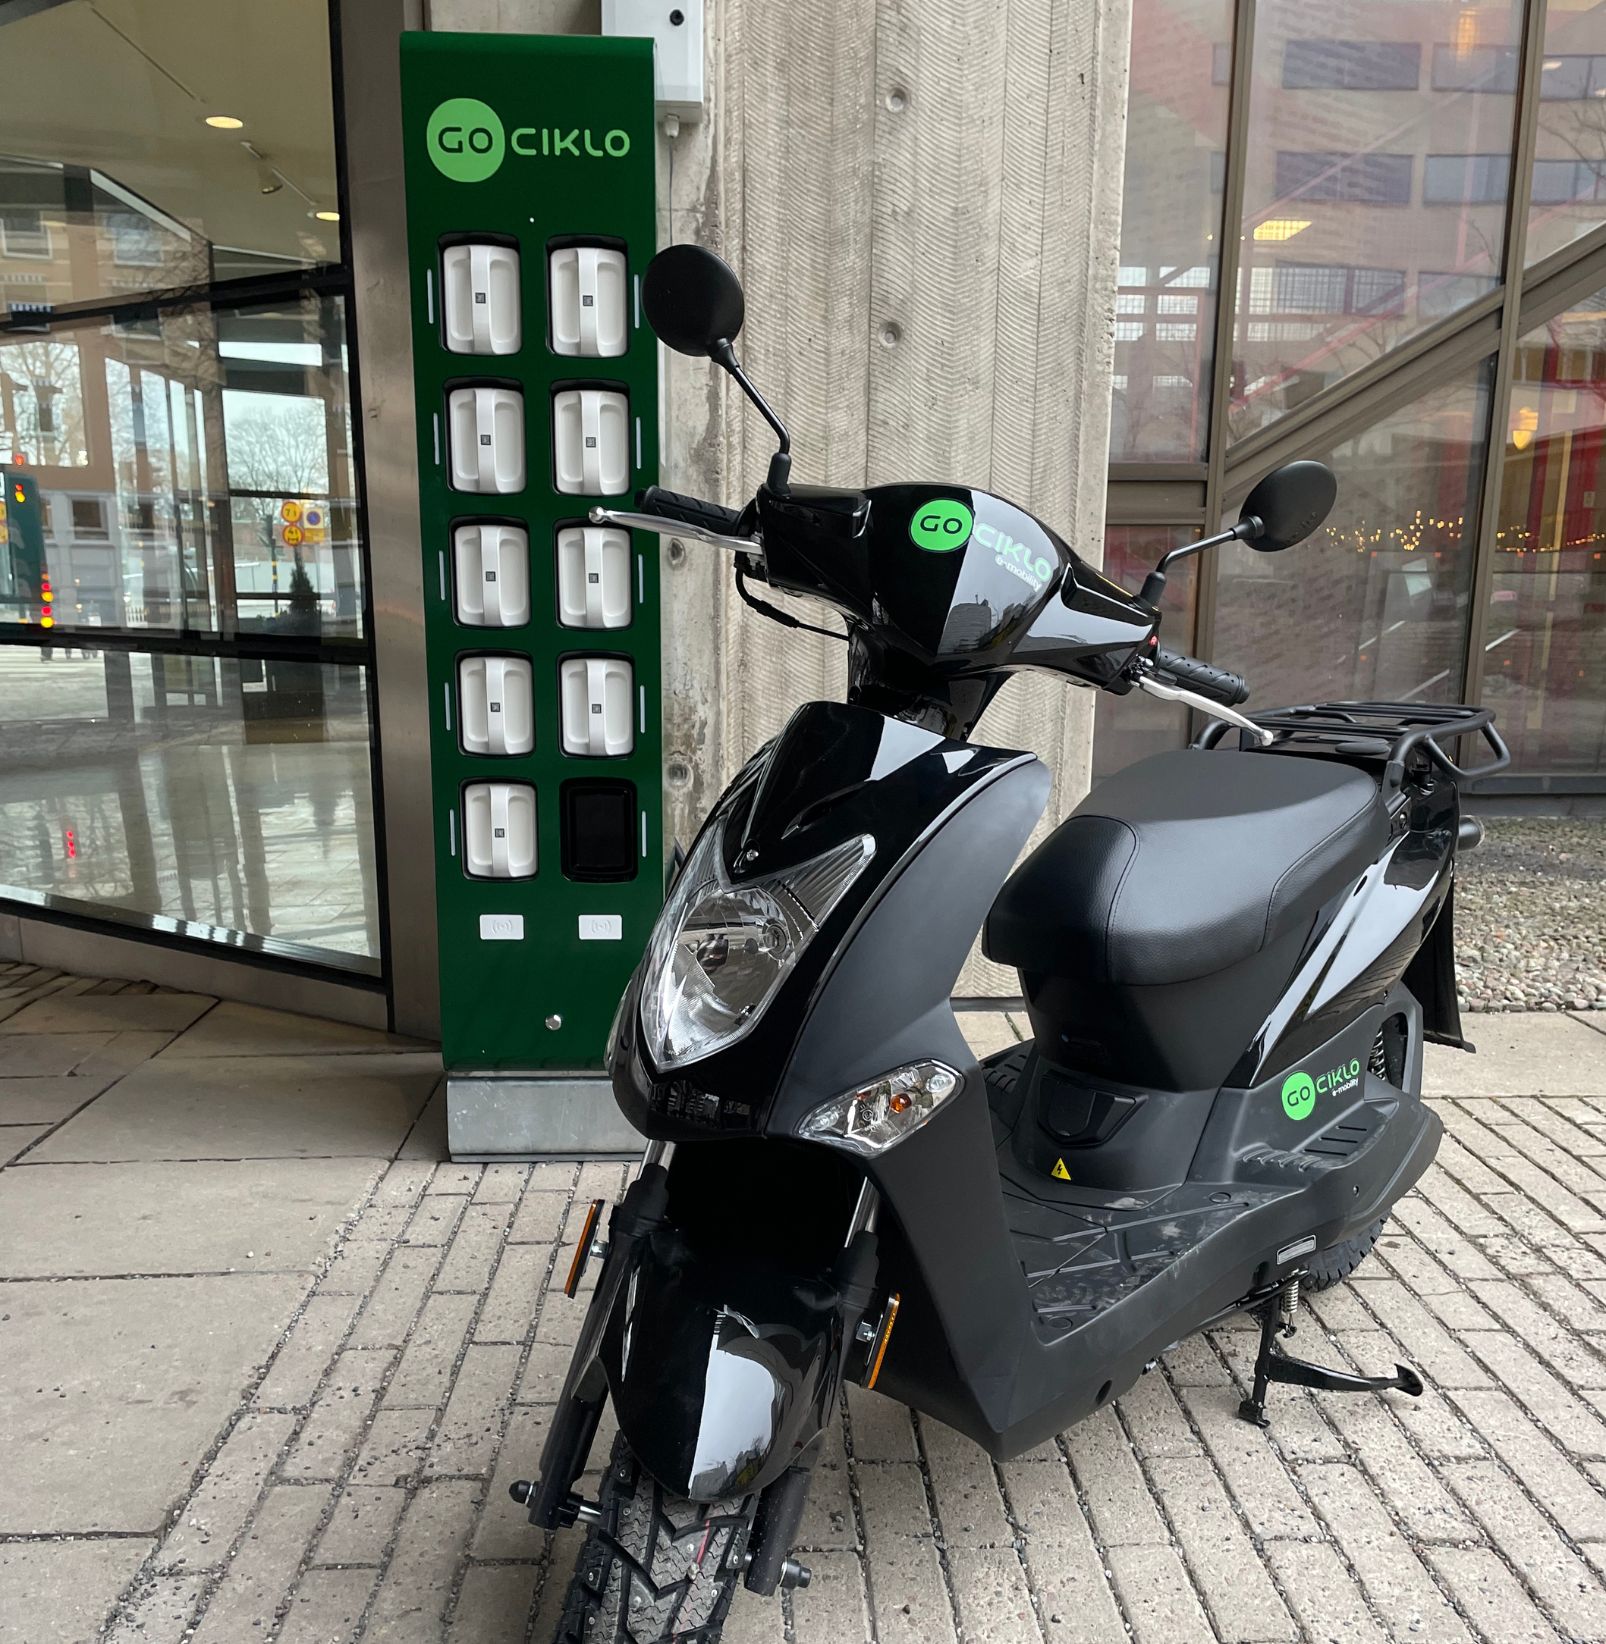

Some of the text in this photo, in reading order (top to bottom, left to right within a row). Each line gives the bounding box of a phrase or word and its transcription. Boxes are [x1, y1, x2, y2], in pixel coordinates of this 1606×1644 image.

[438, 127, 631, 157] GO CIKLO
[920, 515, 1052, 583] GO CIKLO
[995, 554, 1043, 592] e-mobility
[1287, 1060, 1360, 1107] GO CIKLO
